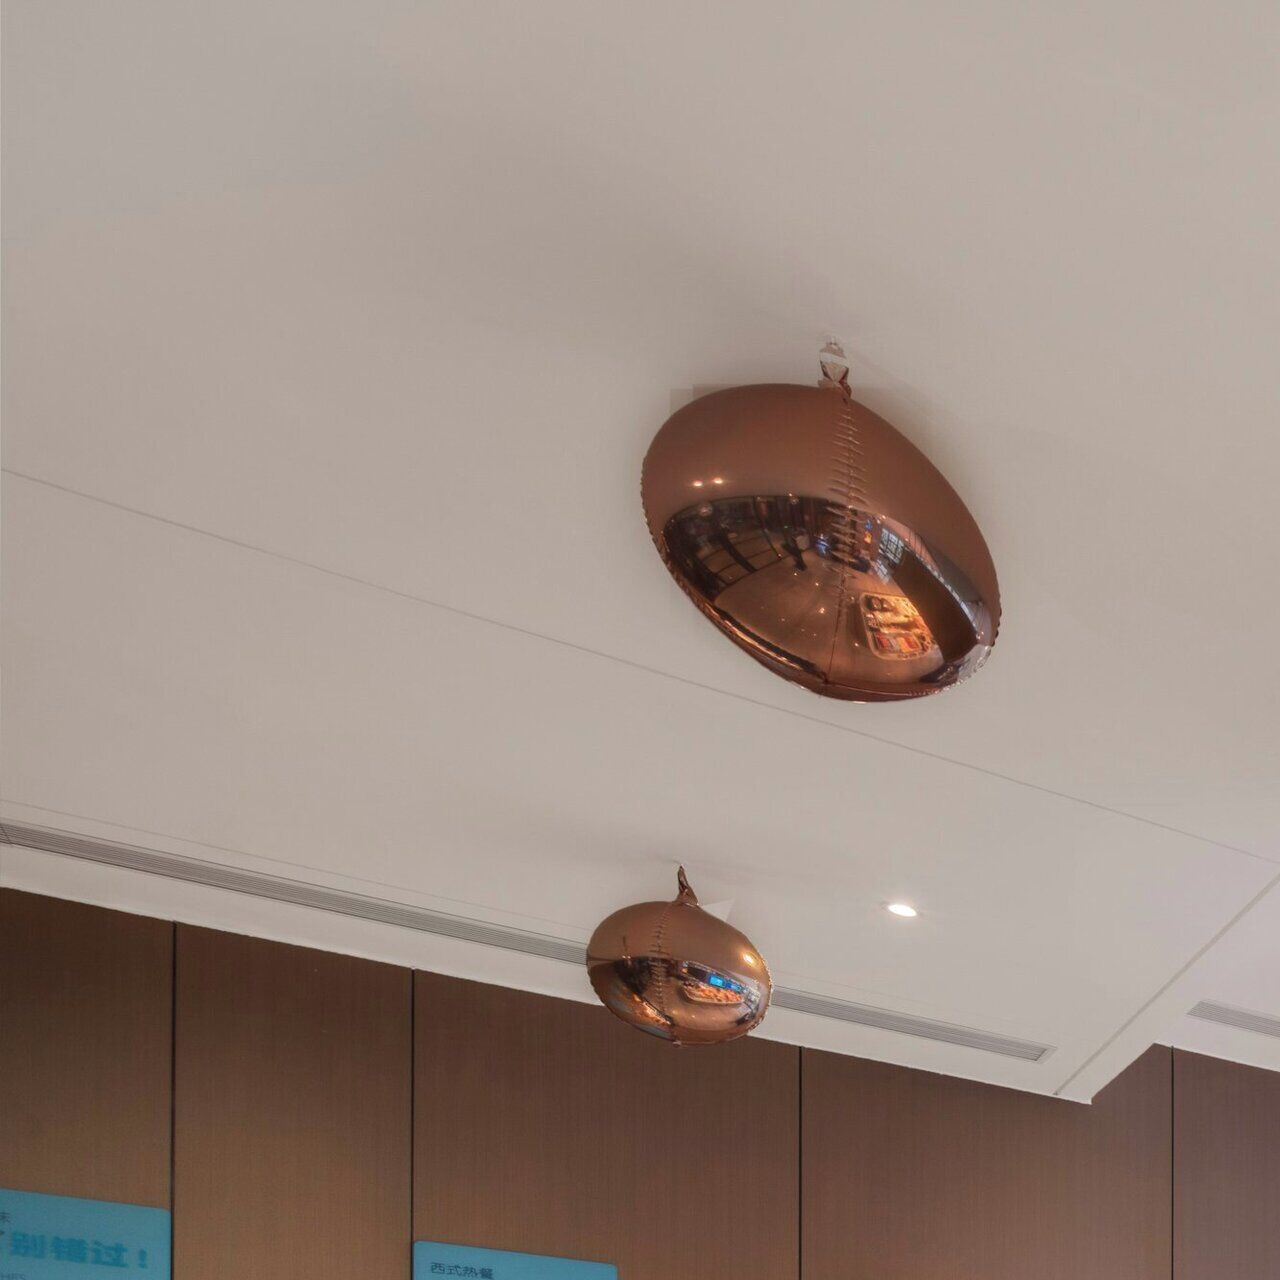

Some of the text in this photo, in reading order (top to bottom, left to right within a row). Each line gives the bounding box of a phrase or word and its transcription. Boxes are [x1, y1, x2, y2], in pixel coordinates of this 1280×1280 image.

[0, 1229, 148, 1269] 别错过！
[430, 1262, 494, 1280] 西式热餐
